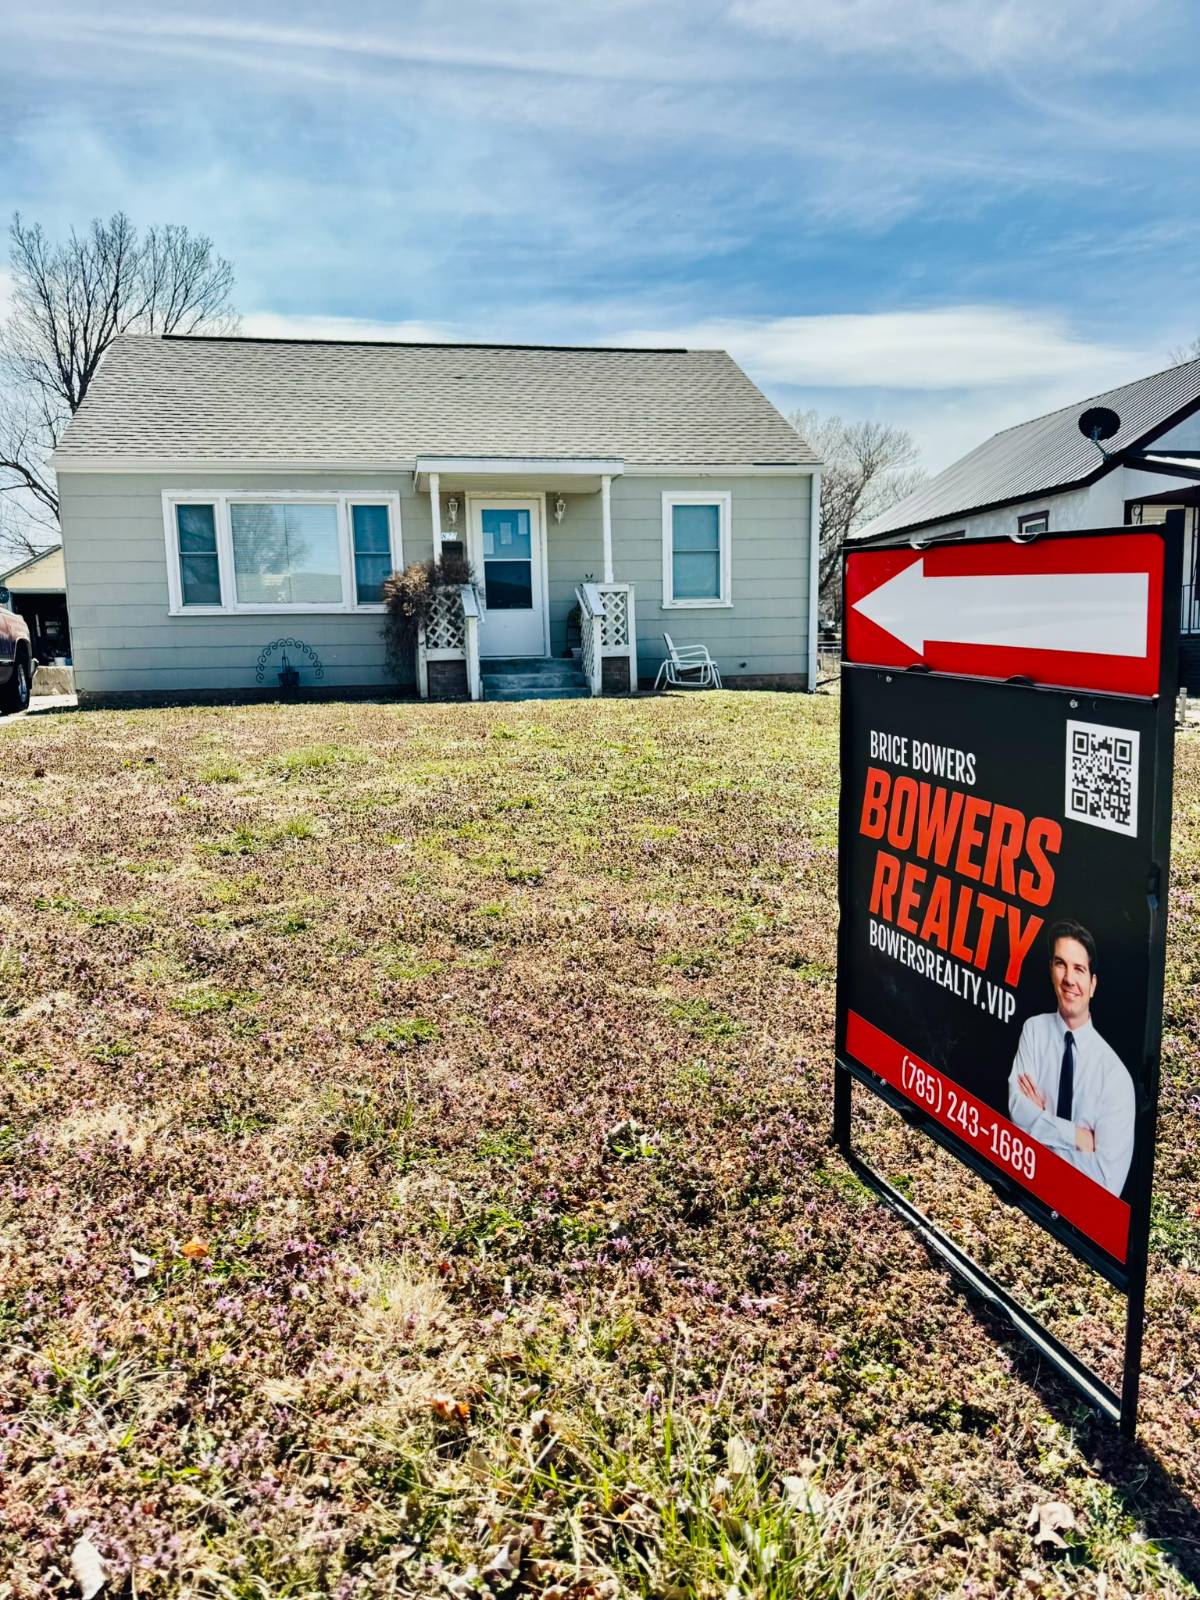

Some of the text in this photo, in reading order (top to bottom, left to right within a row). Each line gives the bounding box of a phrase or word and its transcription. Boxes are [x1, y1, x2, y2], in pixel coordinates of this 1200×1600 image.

[869, 730, 976, 786] BRICE BOWERS
[859, 767, 1063, 907] BOWERS
[869, 850, 1044, 989] REALTY
[869, 919, 1017, 1024] BOWERSREALTY.VIP
[901, 1056, 1036, 1180] (785) 243-1689
